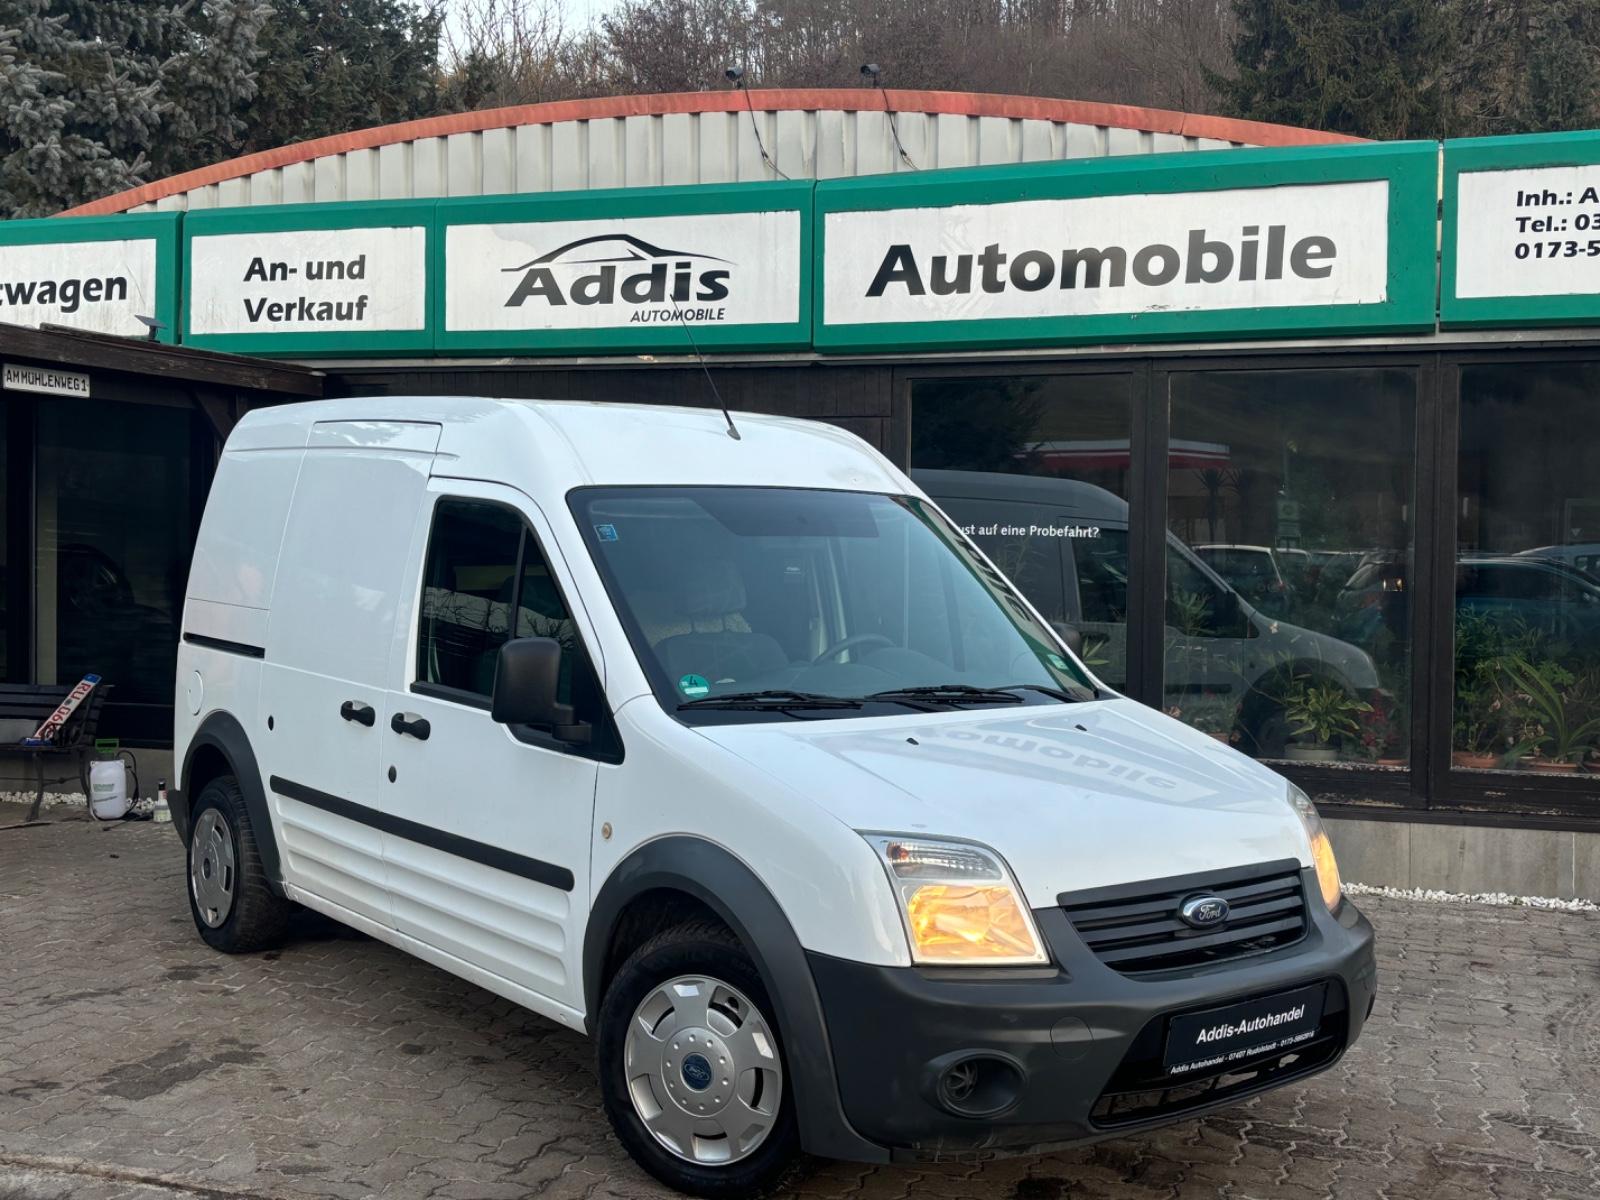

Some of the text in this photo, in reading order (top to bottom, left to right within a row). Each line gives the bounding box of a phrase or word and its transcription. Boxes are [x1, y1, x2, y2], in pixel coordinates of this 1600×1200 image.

[1517, 189, 1572, 207] Inh.:
[1515, 216, 1567, 233] Tel.:
[243, 254, 366, 282] An- und
[865, 224, 1337, 298] Automobile
[504, 262, 730, 307] Addis
[243, 294, 368, 322] Verkauf
[630, 307, 726, 323] AUTOMOBILE
[978, 524, 998, 535] auf
[1001, 525, 1026, 536] eine
[1029, 525, 1100, 538] Probefahrt?
[1199, 903, 1221, 921] Ford
[1196, 1004, 1305, 1045] Addis-Autohandel
